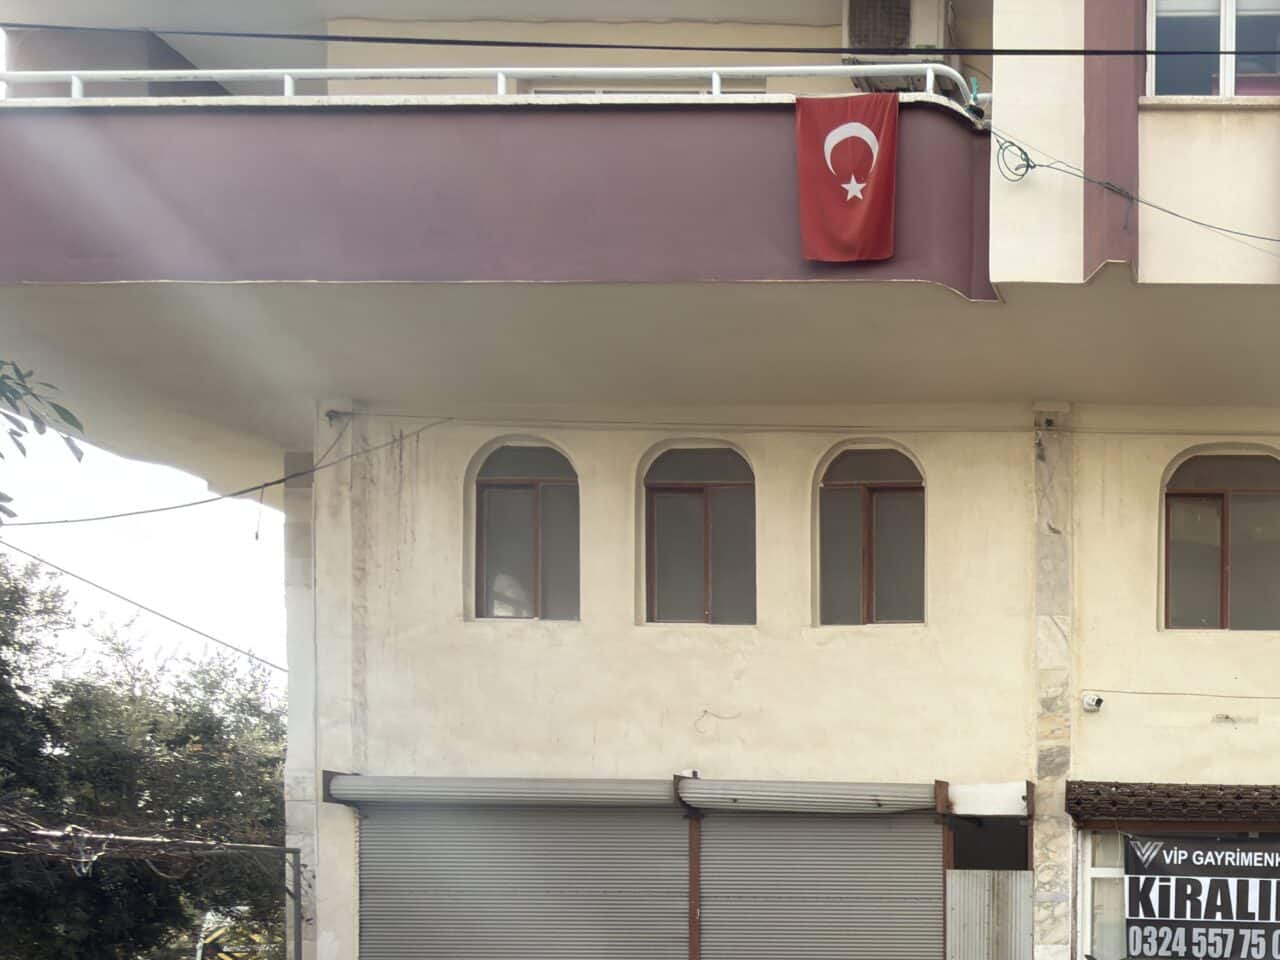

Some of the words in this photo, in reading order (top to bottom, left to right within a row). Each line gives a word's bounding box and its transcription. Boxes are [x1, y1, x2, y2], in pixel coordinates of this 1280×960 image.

[1129, 925, 1187, 957] 0324
[1192, 927, 1235, 959] 557
[1239, 928, 1266, 960] 75
